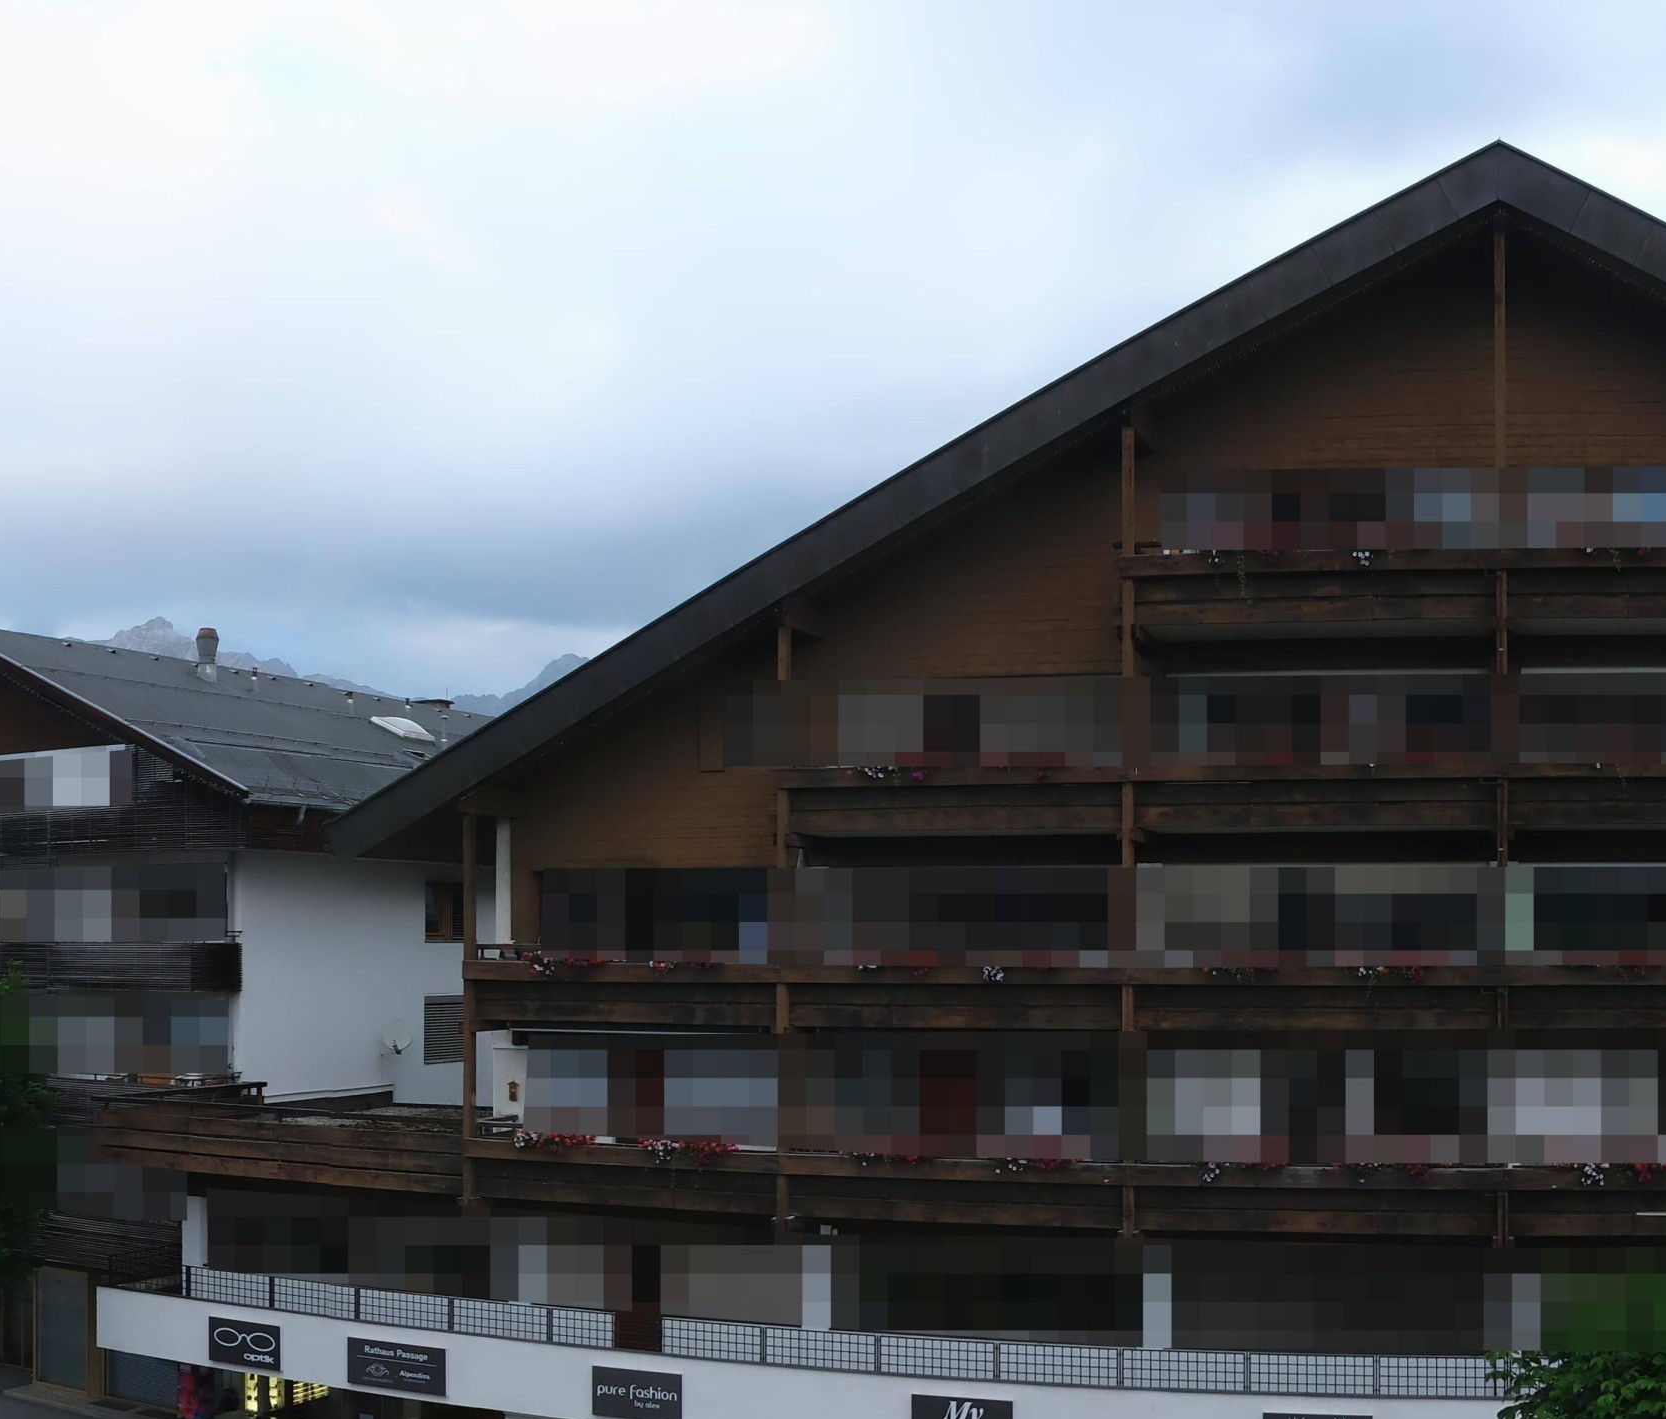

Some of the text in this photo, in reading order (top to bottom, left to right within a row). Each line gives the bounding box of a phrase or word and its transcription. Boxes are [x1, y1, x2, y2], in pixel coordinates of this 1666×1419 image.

[243, 1353, 274, 1364] optik
[364, 1346, 428, 1362] Rathaus Passage
[597, 1384, 677, 1402] pure fashion
